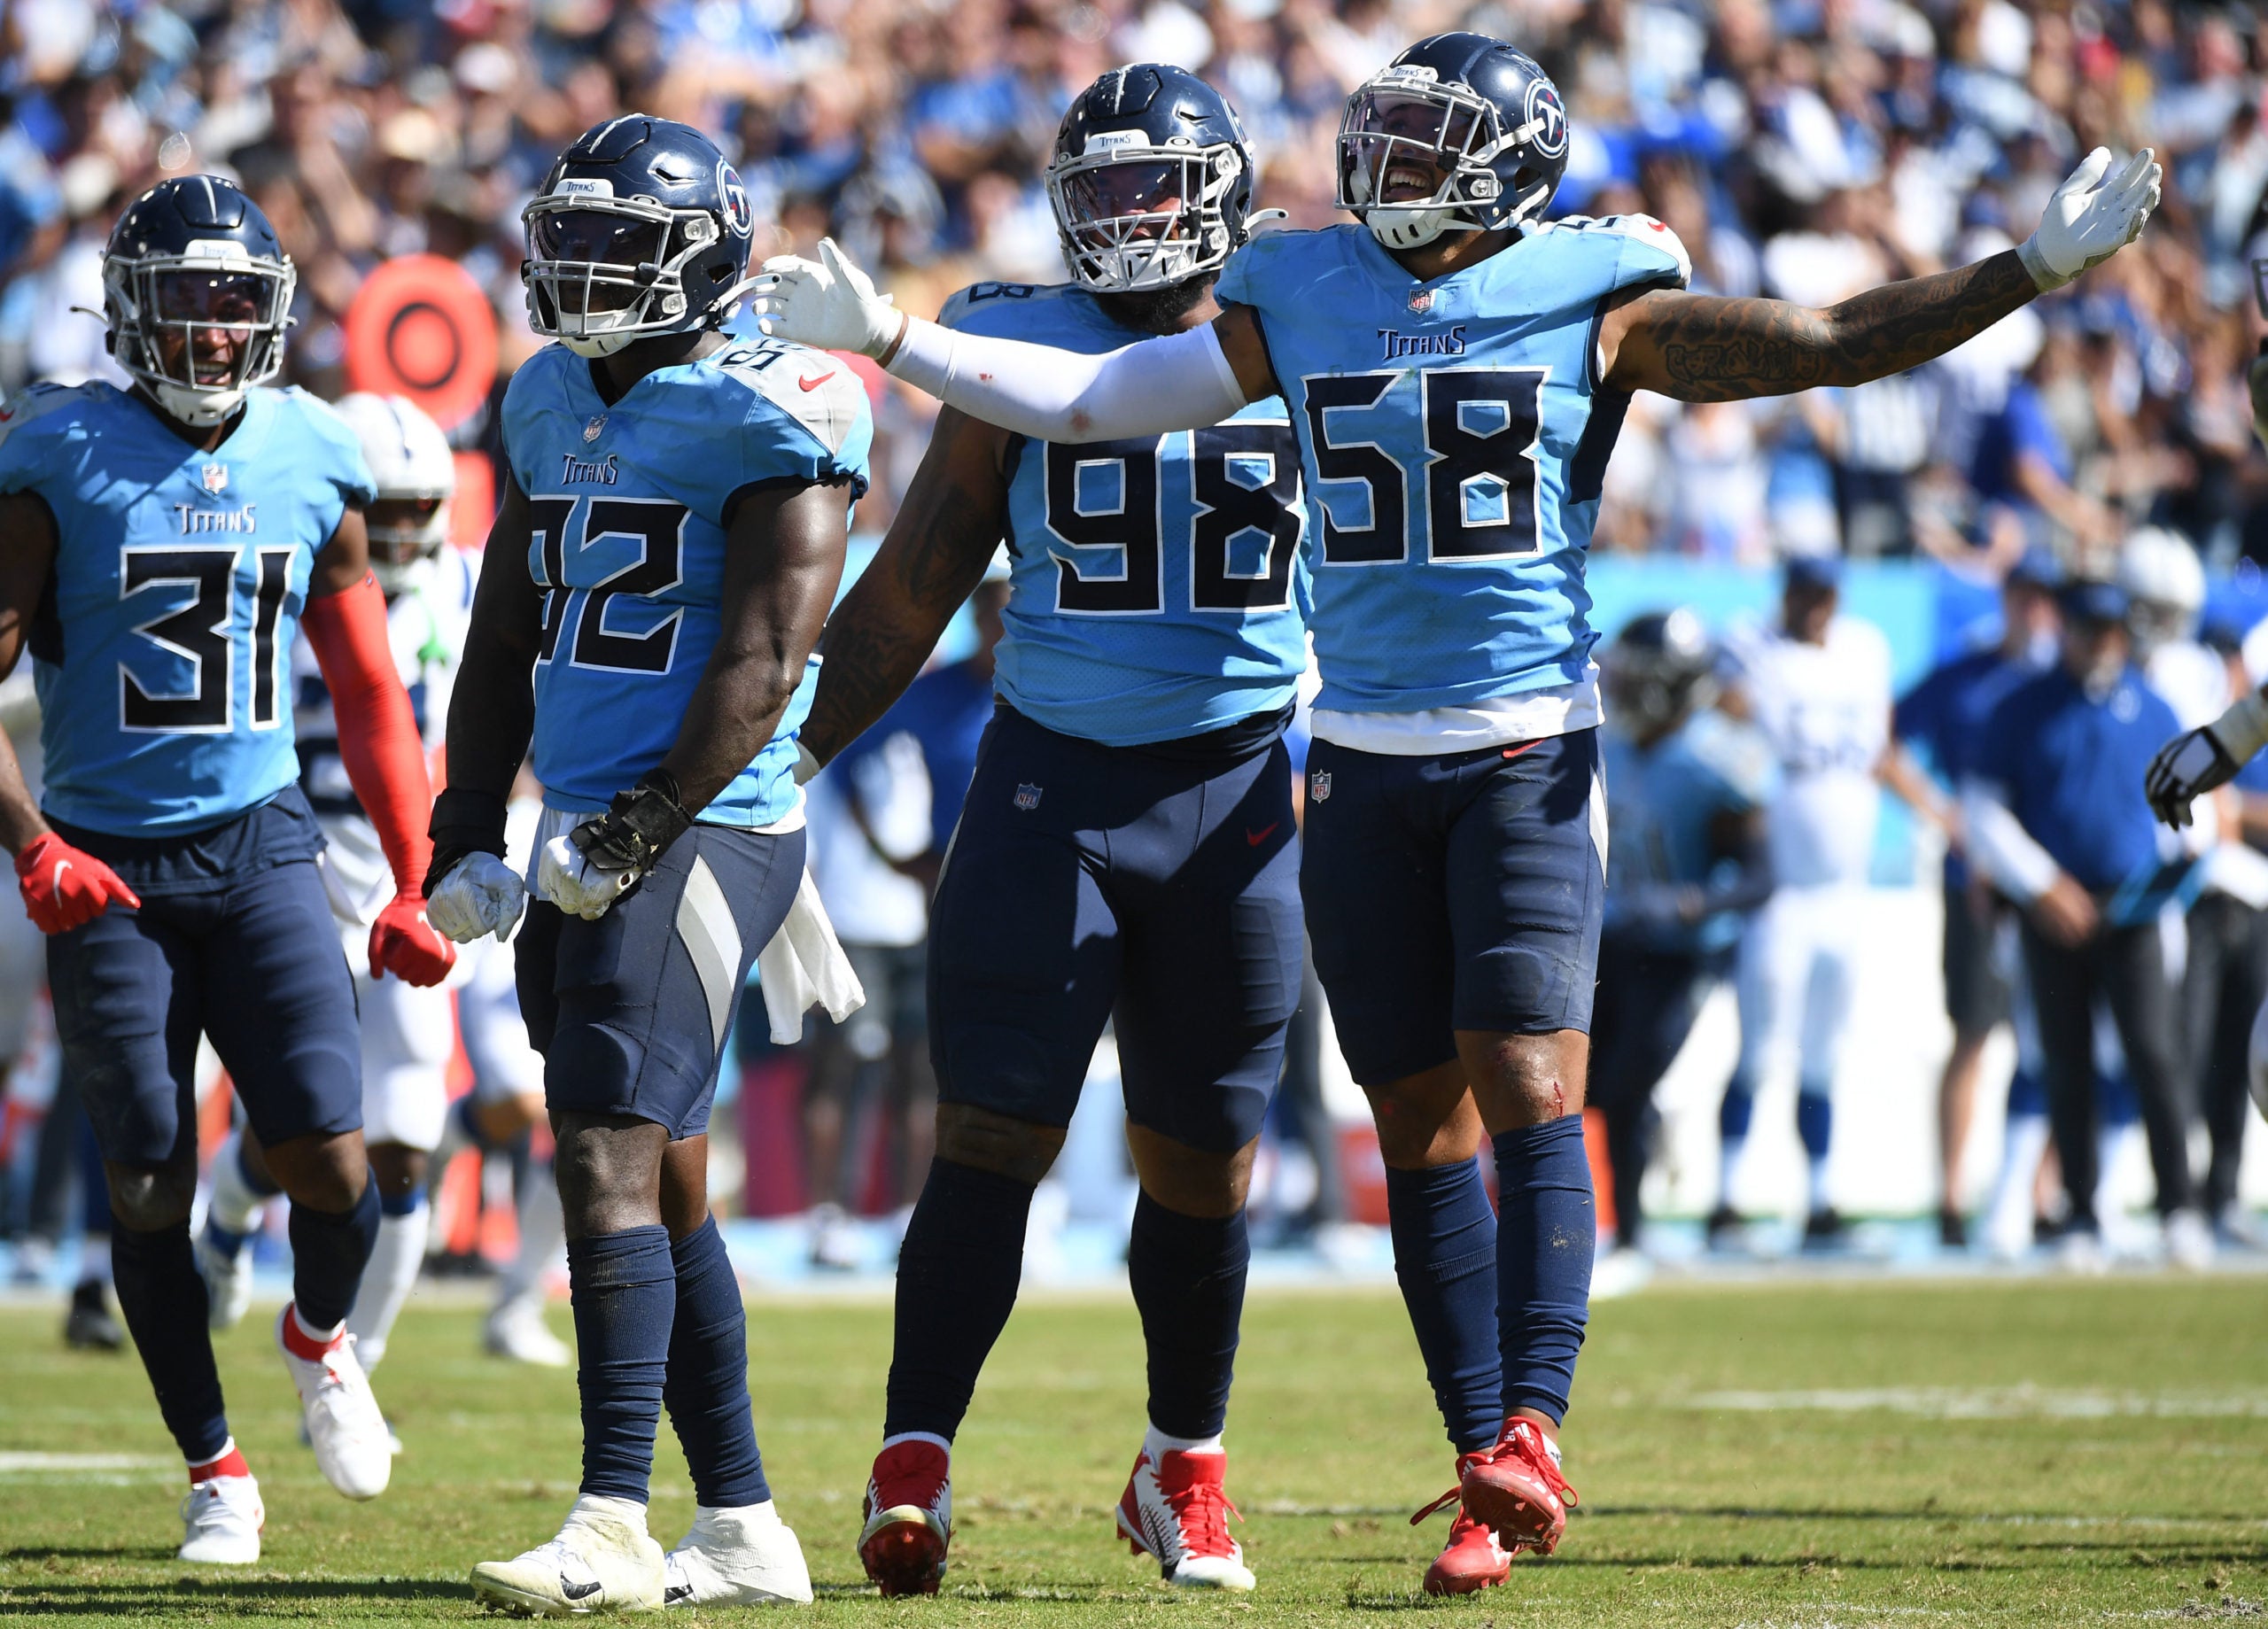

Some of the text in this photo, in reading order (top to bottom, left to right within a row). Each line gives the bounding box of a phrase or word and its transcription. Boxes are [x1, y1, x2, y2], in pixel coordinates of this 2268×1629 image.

[1394, 67, 1422, 77] TITANS
[1099, 134, 1131, 147] TITANS
[567, 181, 596, 192] TITANS
[1377, 324, 1466, 361] TITANS
[561, 453, 618, 485] TITANS
[1301, 366, 1553, 566] 58
[173, 502, 257, 536] TITANS
[1044, 419, 1305, 616] 98
[119, 544, 299, 733] 31
